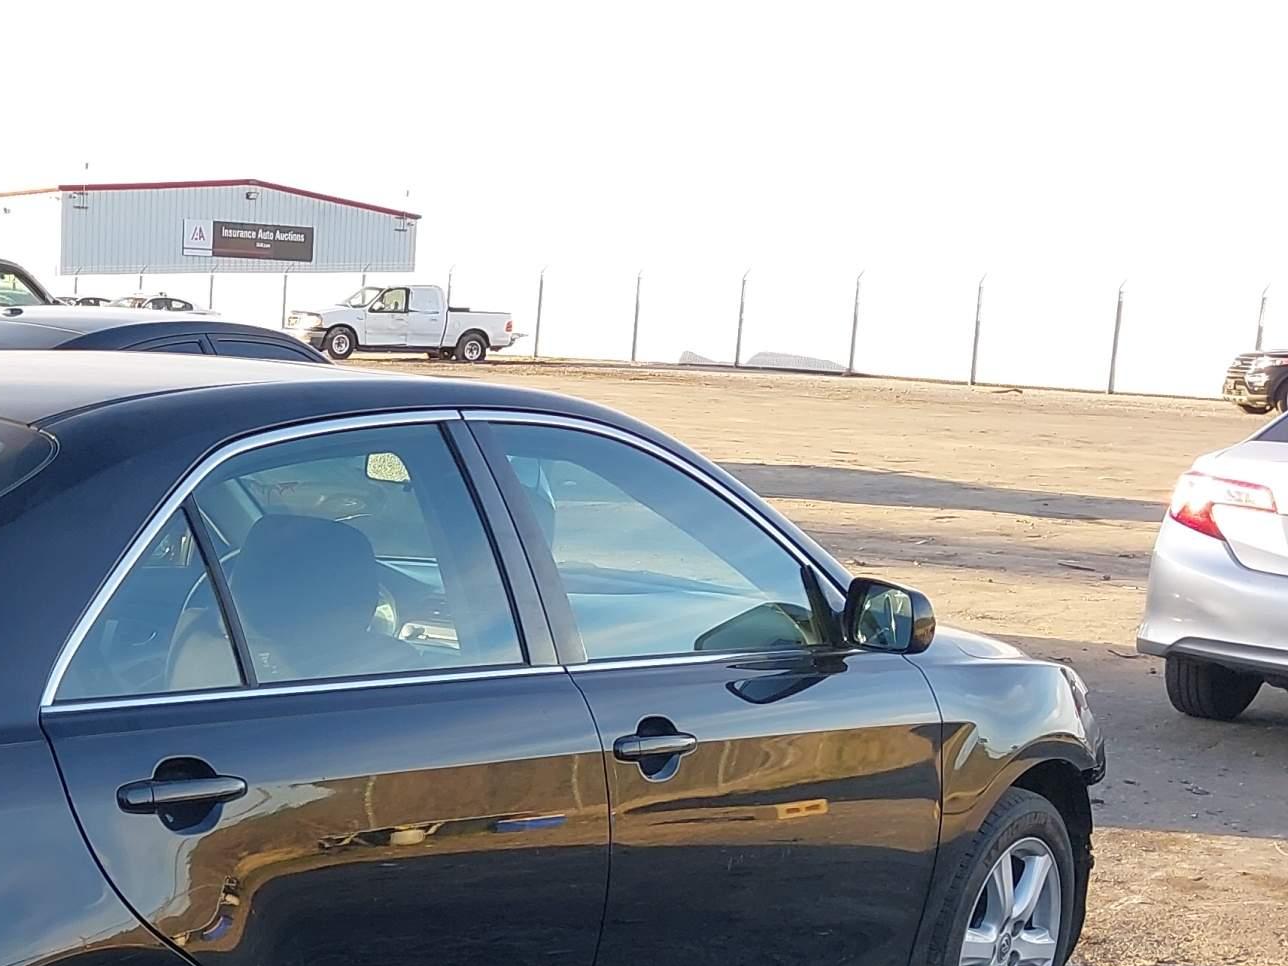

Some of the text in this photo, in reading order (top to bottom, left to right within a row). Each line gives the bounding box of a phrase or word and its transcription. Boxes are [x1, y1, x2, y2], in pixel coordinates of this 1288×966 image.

[222, 226, 305, 242] Insurance Auto Auctions
